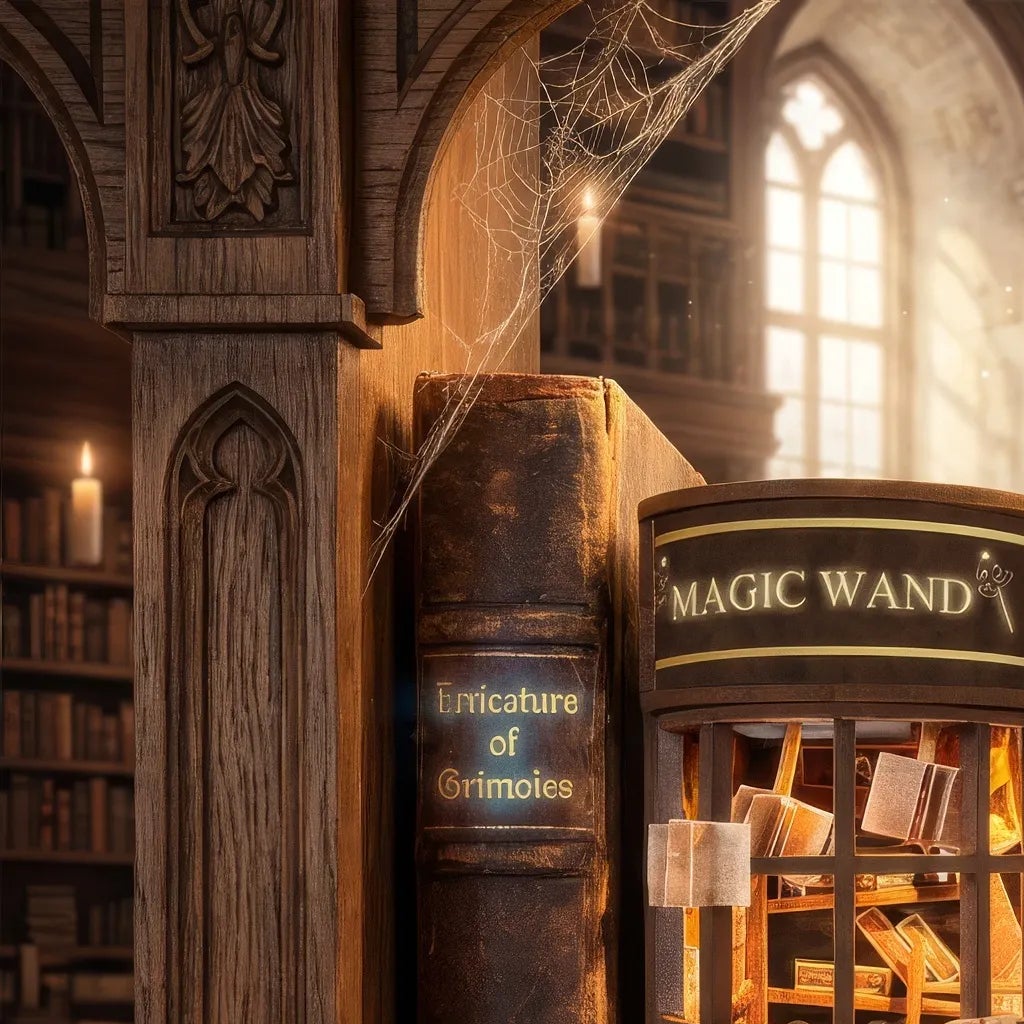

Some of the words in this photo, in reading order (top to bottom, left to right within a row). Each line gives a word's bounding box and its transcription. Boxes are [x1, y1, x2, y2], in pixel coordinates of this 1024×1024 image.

[672, 570, 807, 621] MAGIC
[818, 570, 973, 615] WAND
[489, 726, 520, 757] of
